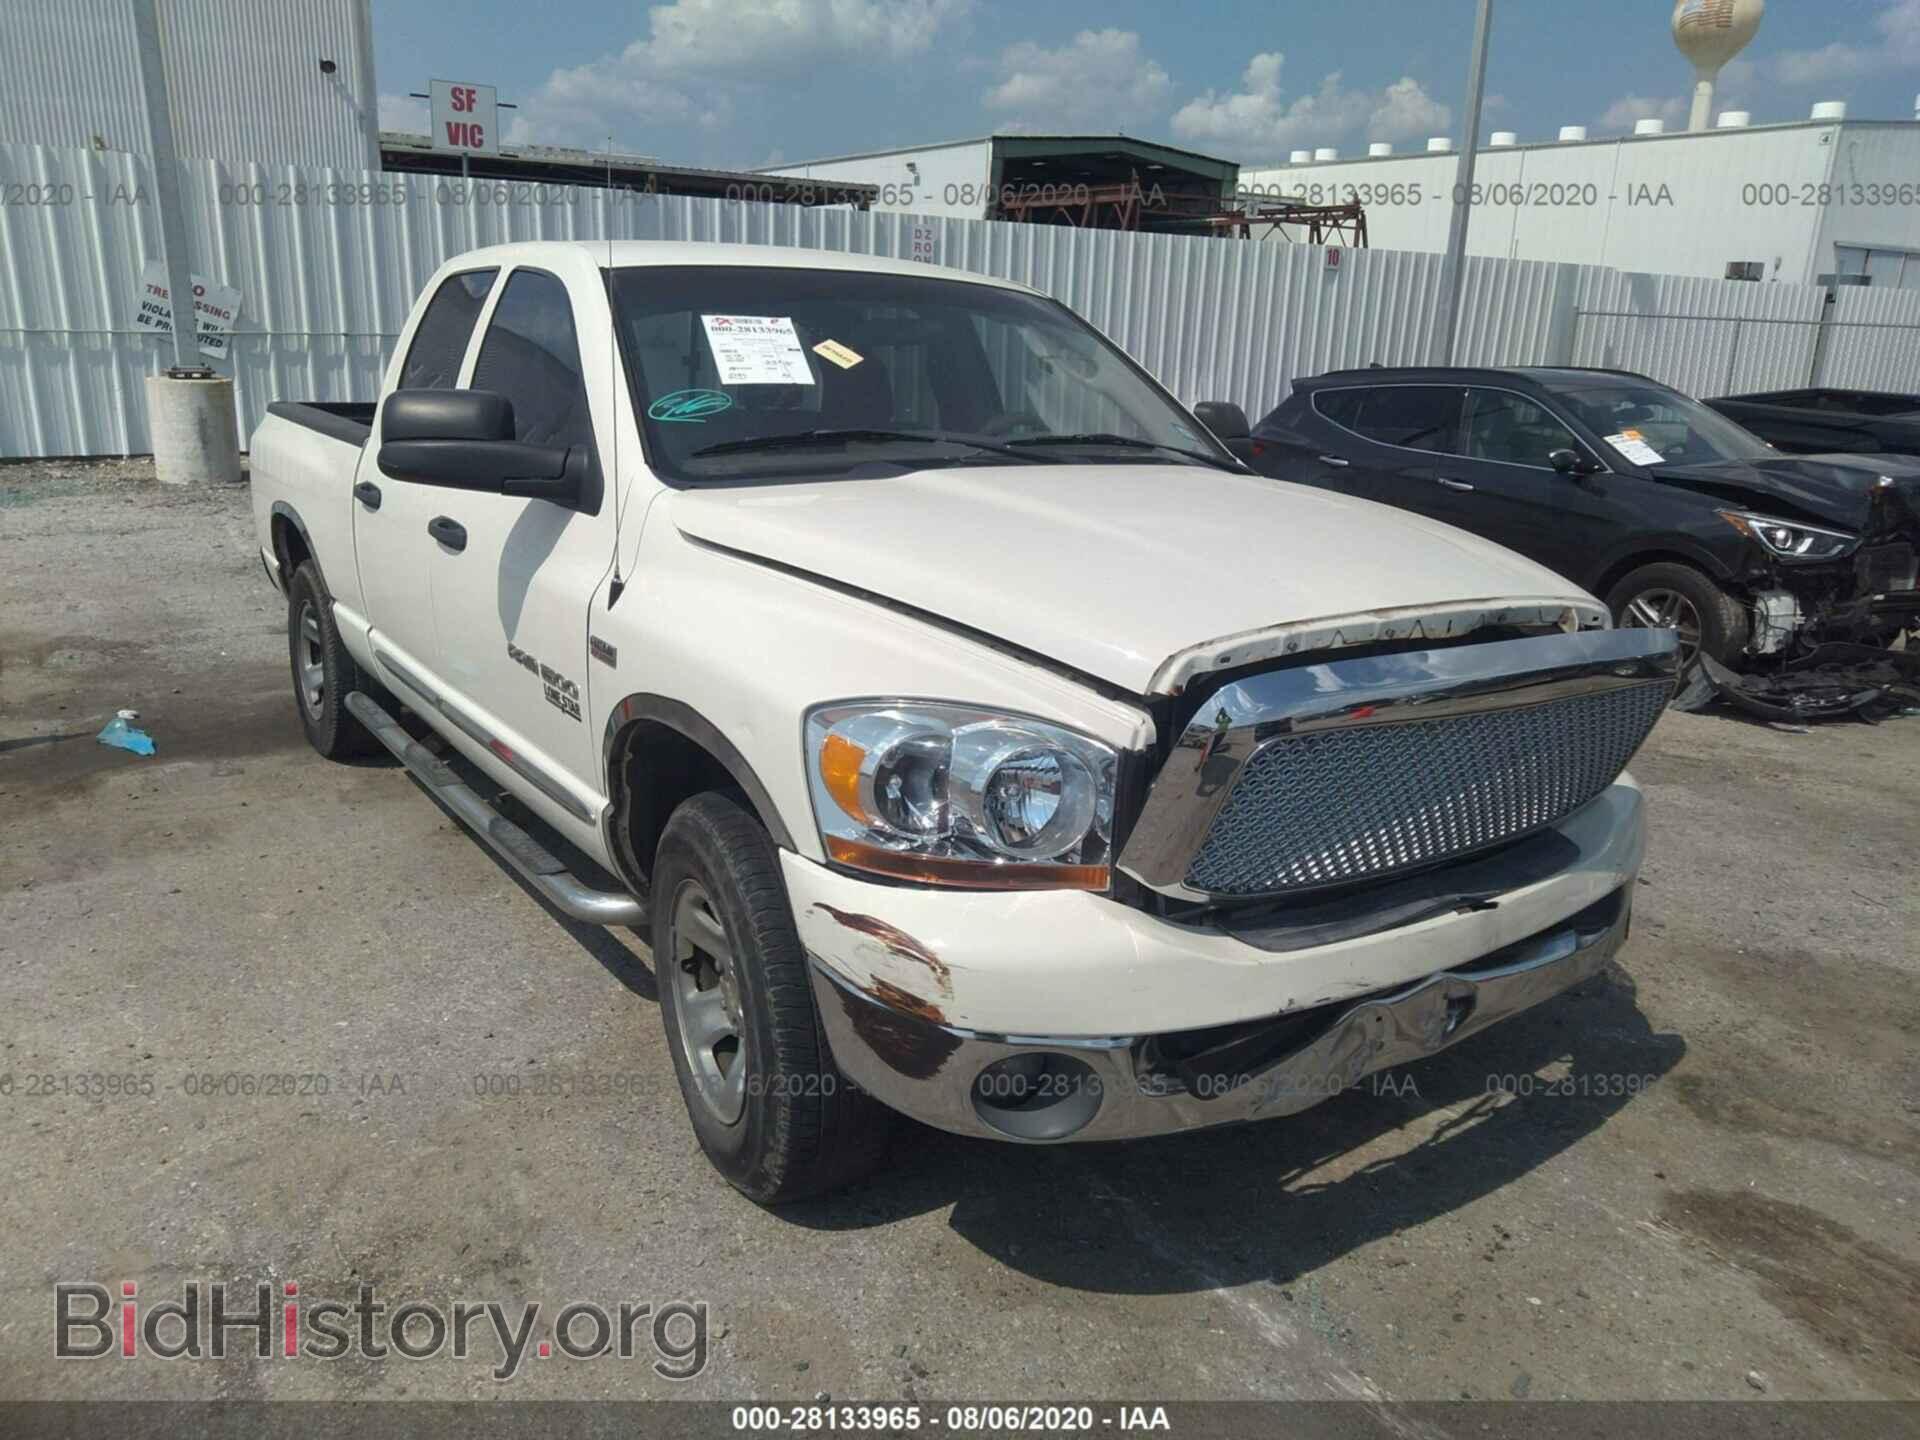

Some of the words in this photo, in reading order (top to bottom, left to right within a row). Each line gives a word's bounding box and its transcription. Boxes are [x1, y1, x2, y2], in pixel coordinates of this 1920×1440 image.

[451, 86, 476, 112] SF
[446, 121, 484, 149] VIC
[1327, 247, 1340, 266] 10
[137, 313, 153, 326] BE
